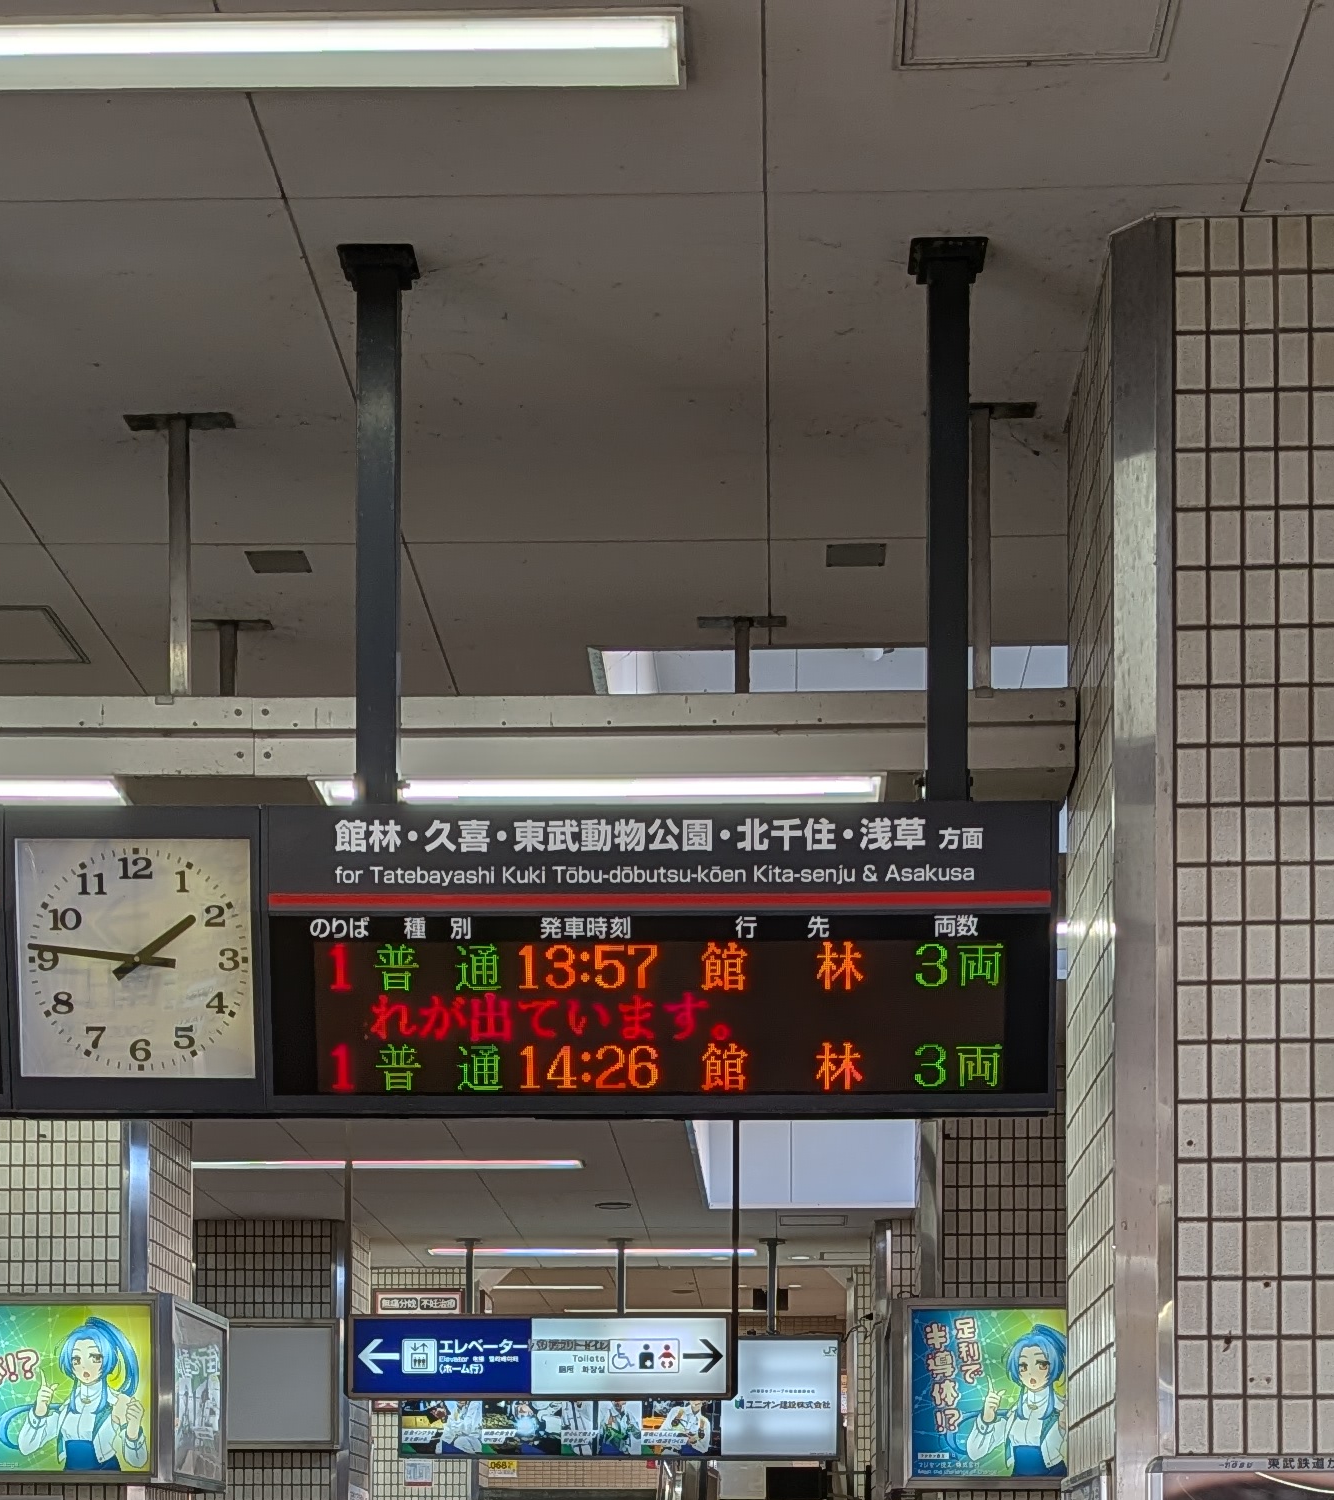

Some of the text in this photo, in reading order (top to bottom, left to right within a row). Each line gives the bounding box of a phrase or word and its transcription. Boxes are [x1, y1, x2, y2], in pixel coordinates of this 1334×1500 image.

[334, 816, 983, 853] 館林・久喜・東武動物公園・北千住・浅草 方面
[118, 857, 153, 880] 12
[334, 861, 975, 887] for Tatebayashi Kuki Tōbu-dōbutsu-kōen Kita-senju & Asakusa
[77, 872, 107, 895] 11
[175, 870, 189, 893] 1
[48, 907, 82, 931] 10
[204, 904, 226, 928] 2
[310, 915, 370, 939] のりば
[540, 914, 632, 940] 発車時刻
[933, 914, 979, 939] 両数
[37, 949, 60, 971] 9
[218, 948, 240, 971] 3
[328, 944, 353, 992] 1
[518, 944, 659, 991] 13:57
[913, 942, 1004, 991] 3両
[51, 991, 74, 1015] 8
[205, 991, 229, 1015] 4
[369, 994, 732, 1042] れが出ています。
[85, 1026, 107, 1049] 7
[173, 1025, 195, 1050] 5
[129, 1038, 152, 1062] 6
[330, 1045, 354, 1093] 1
[519, 1045, 659, 1092] 14:26
[913, 1043, 1003, 1092] 3両
[438, 1338, 530, 1355] エレベーター
[572, 1354, 606, 1363] Toilets
